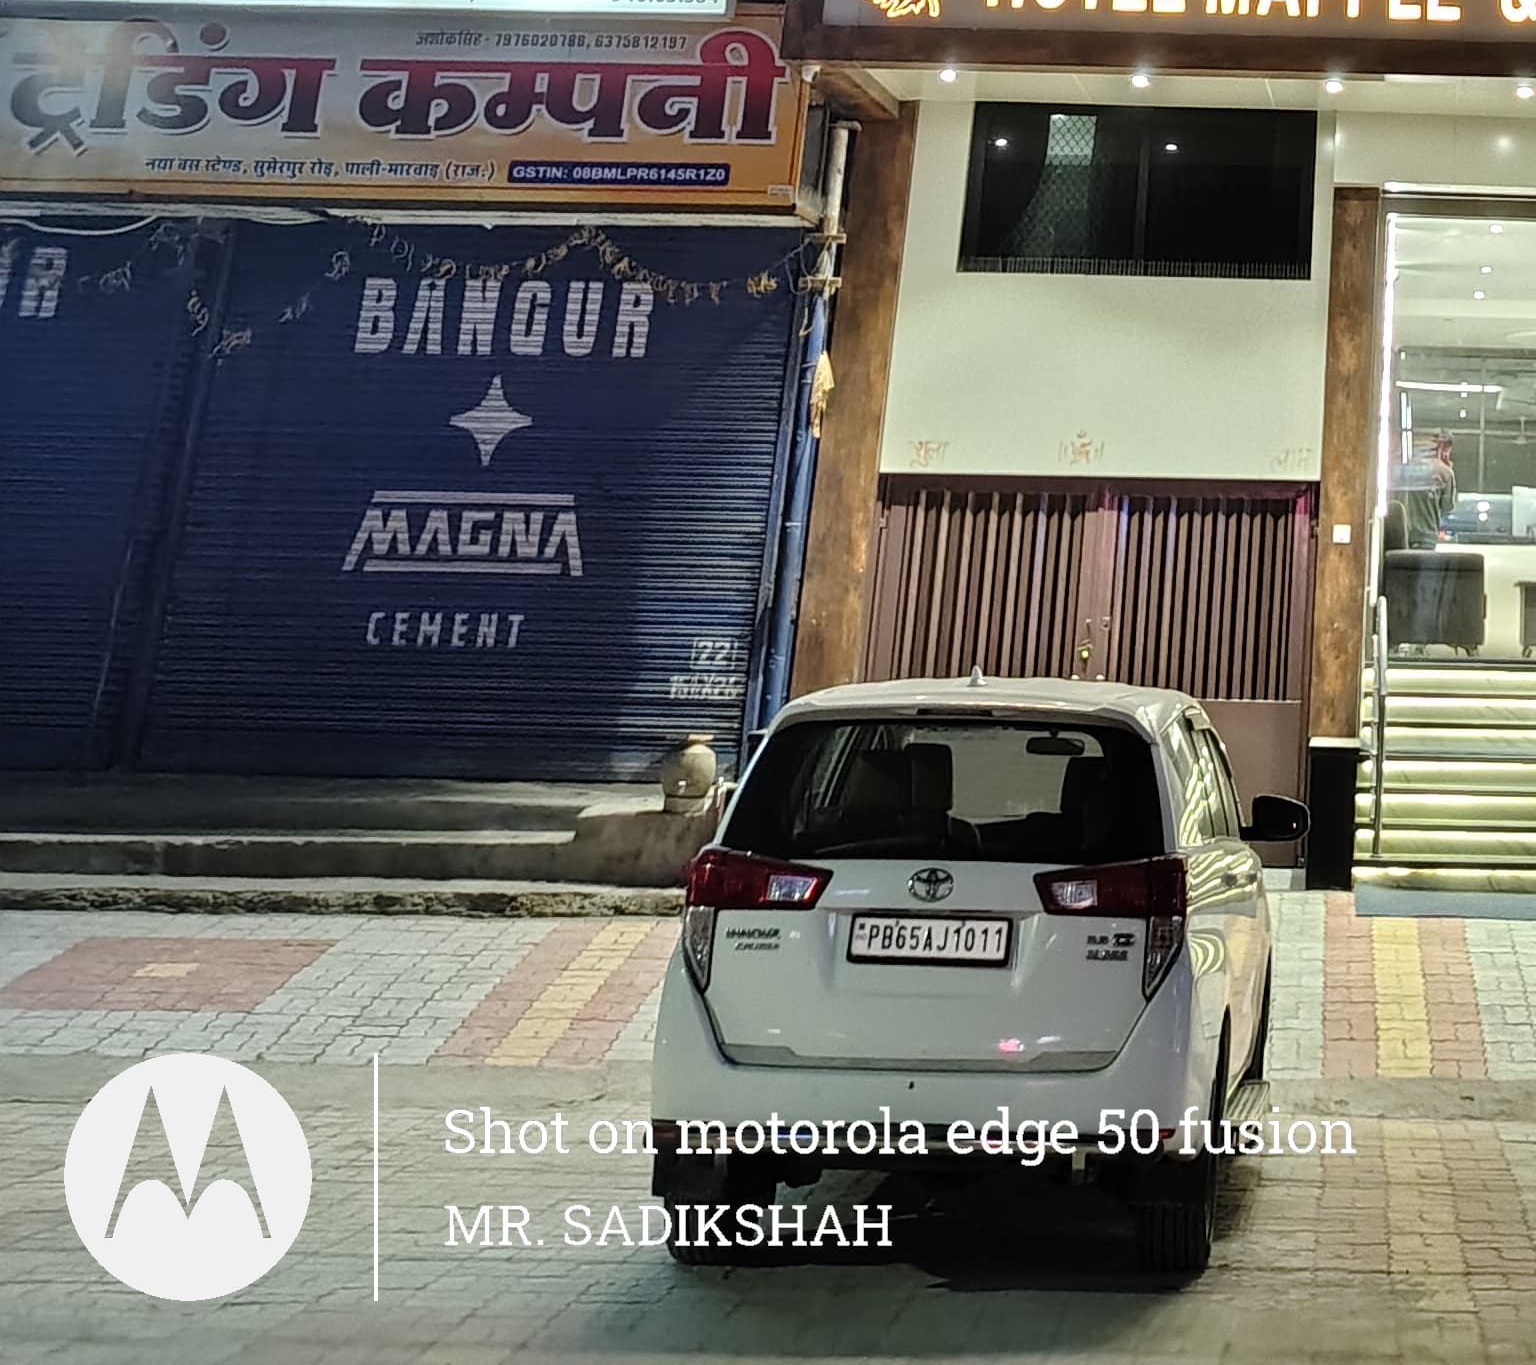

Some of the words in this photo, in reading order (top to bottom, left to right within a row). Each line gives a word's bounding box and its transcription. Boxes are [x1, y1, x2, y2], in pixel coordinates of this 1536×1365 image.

[359, 29, 787, 141] कम्पनी
[513, 165, 568, 179] GSTIN:
[354, 276, 655, 358] BANGUR
[342, 509, 583, 576] MAGNA
[367, 611, 527, 649] CEMENT
[867, 924, 1003, 953] PB65AJ1011
